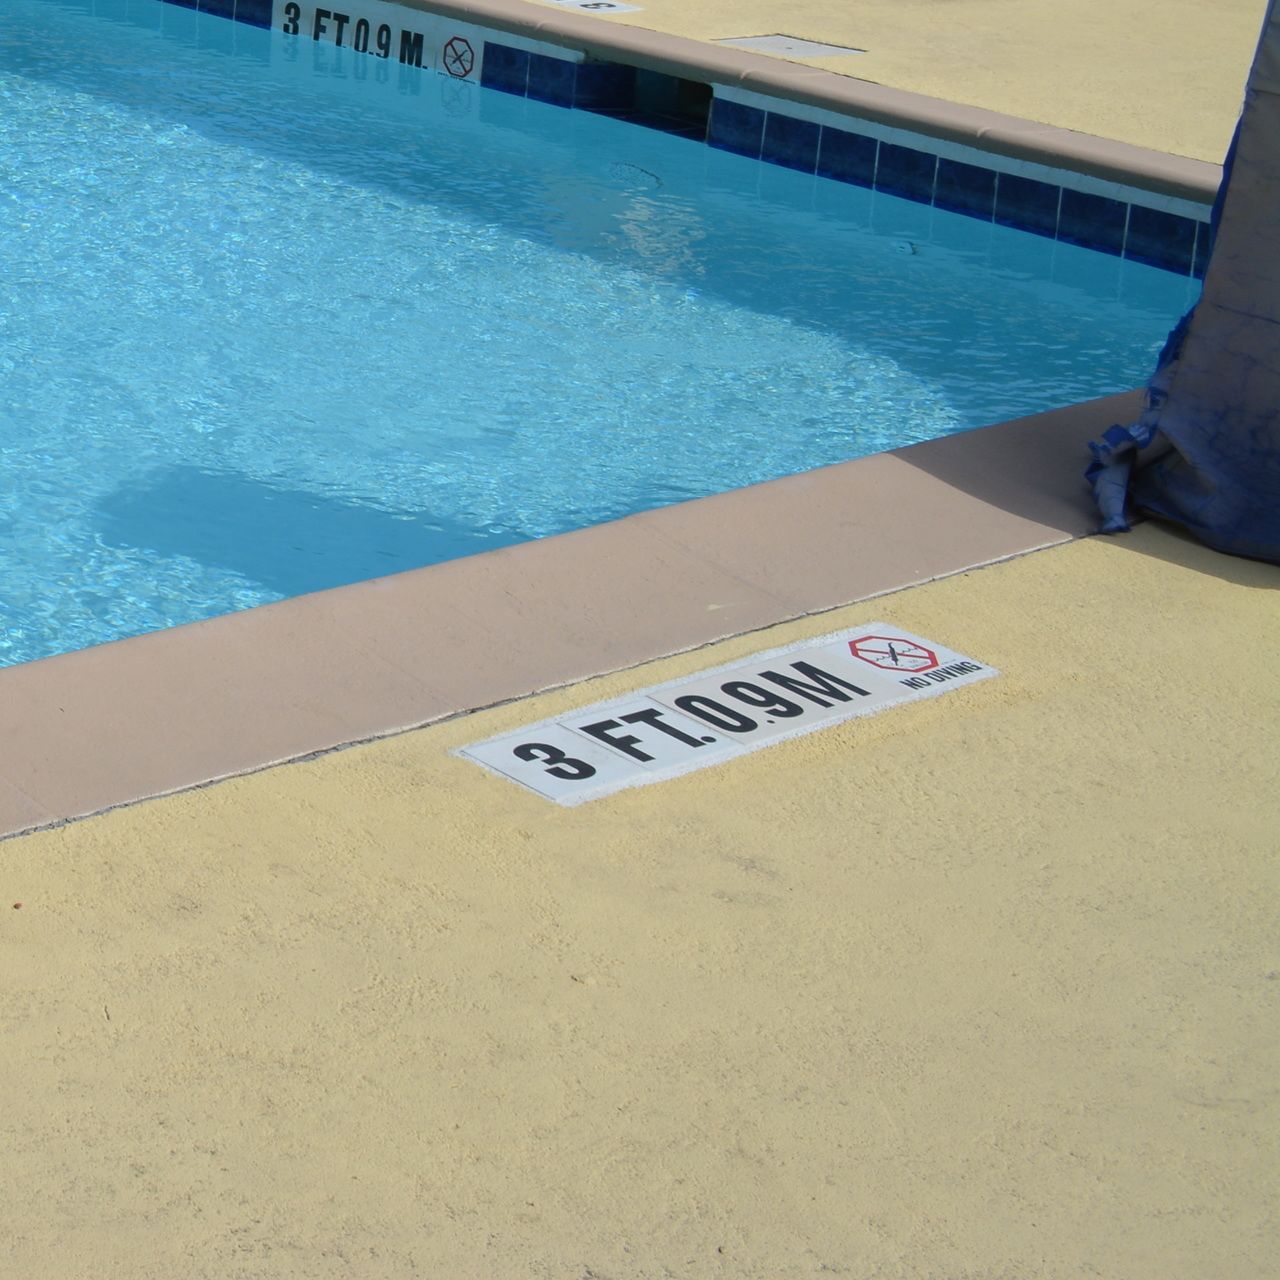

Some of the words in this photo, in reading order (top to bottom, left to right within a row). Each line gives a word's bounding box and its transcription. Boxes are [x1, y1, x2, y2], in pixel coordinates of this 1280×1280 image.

[283, 1, 300, 35] 3
[899, 676, 932, 690] NO
[923, 661, 983, 683] DIVING
[513, 742, 597, 780] 3
